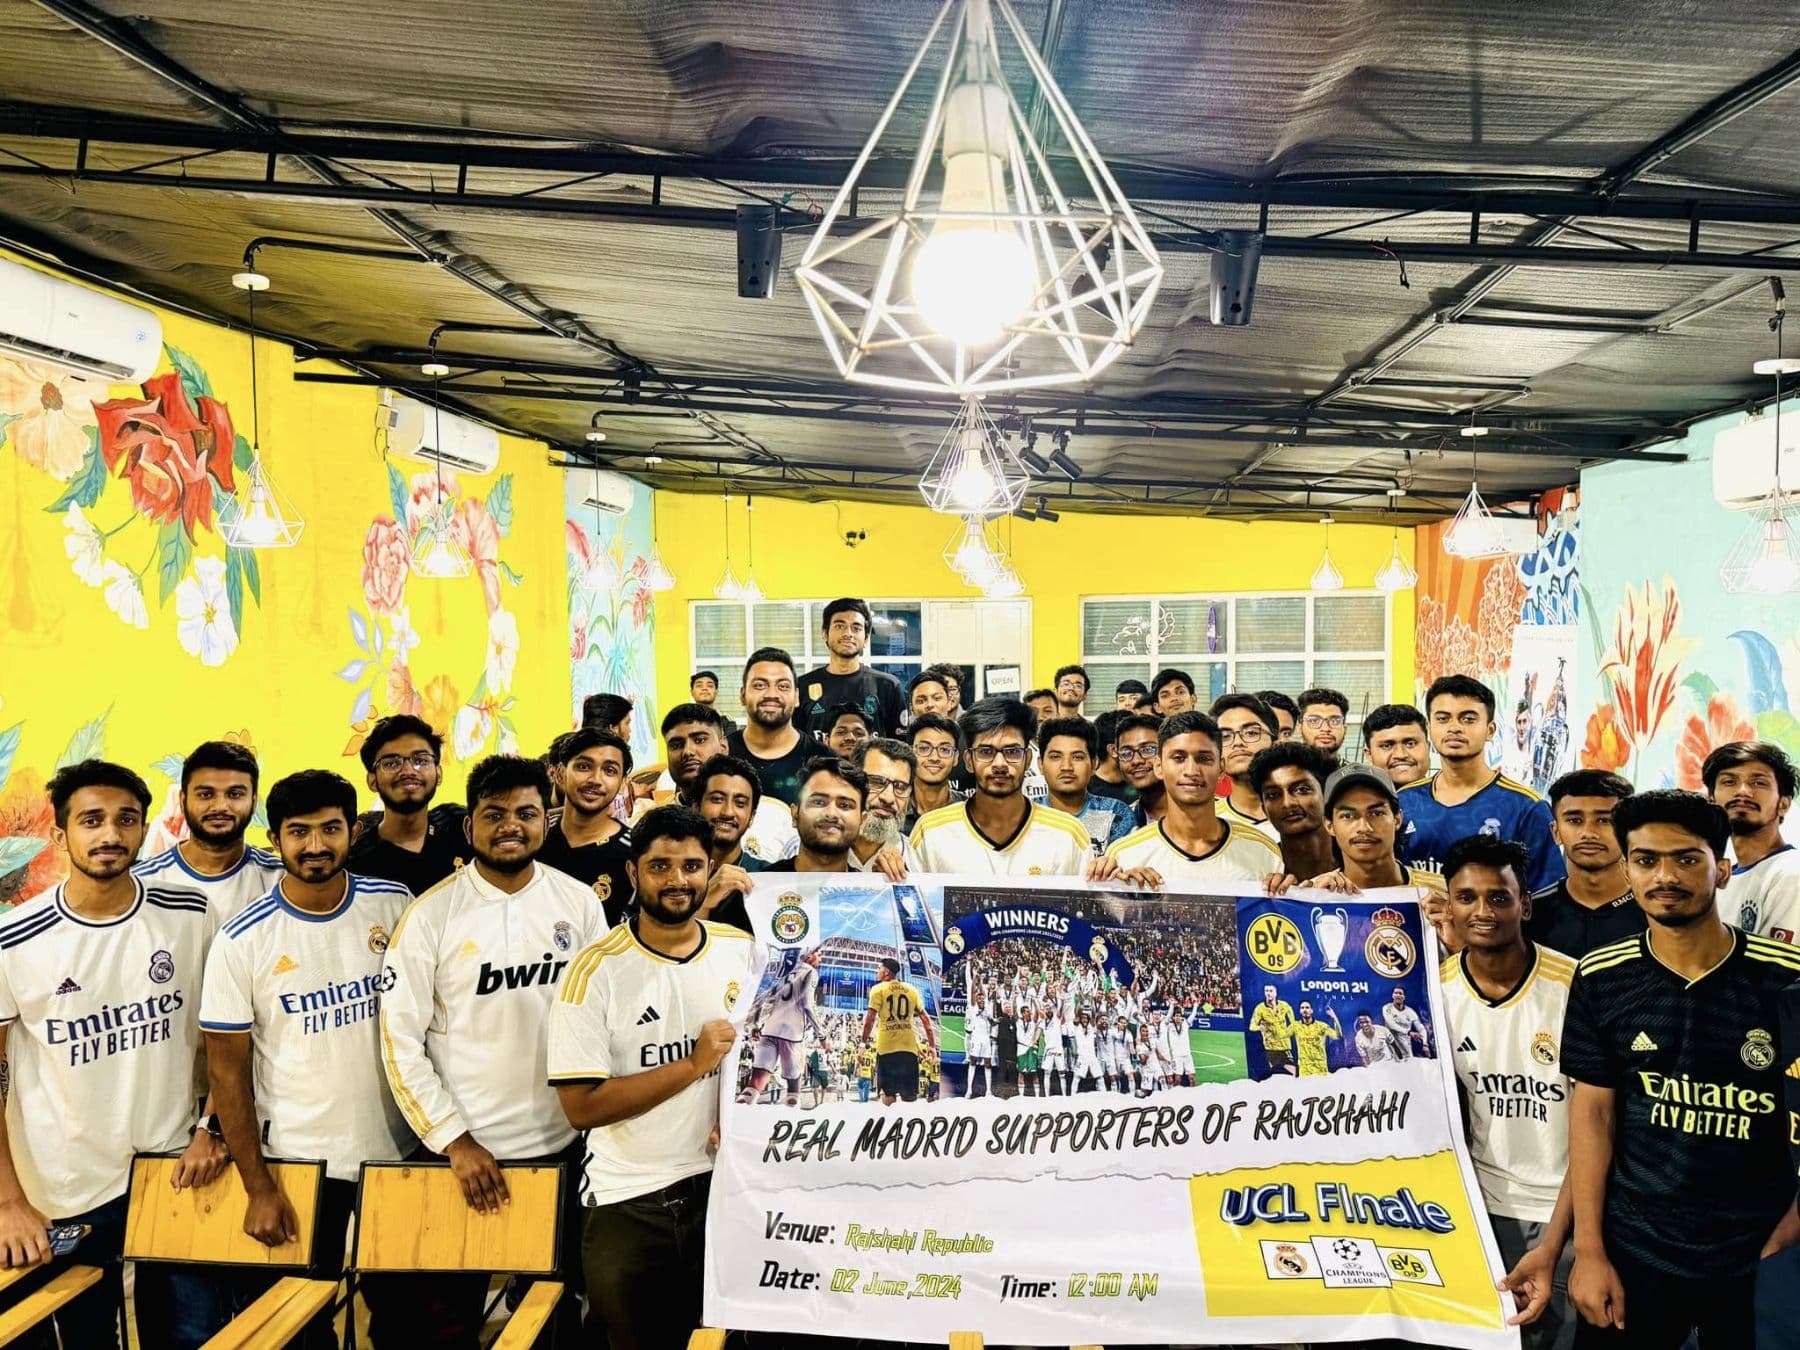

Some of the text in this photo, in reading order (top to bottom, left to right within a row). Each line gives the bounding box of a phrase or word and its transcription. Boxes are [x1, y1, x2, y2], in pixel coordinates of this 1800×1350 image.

[984, 909, 1070, 934] WINNERS
[1253, 919, 1299, 955] BVB
[1267, 954, 1285, 967] 09
[278, 973, 382, 1014] Emirate
[1351, 981, 1370, 994] 24
[46, 989, 184, 1044] Emirates
[886, 993, 909, 1021] 10
[941, 1004, 967, 1014] EAGU
[304, 1012, 328, 1035] FLY
[70, 1018, 171, 1067] FLY BETTER
[762, 1091, 1410, 1163] REAL MADRID SUPPORTERS OF RAJSHAHI
[1650, 1102, 1751, 1140] FLY BETTER
[1219, 1183, 1310, 1225] UCL
[764, 1210, 994, 1256] Venue: Rajshahi Republic
[758, 1261, 820, 1291] Date:
[830, 1269, 860, 1293] 02
[1000, 1272, 1159, 1302] Time: 12:00 AM
[1325, 1269, 1388, 1279] CHAMPIONS
[1342, 1277, 1374, 1285] LEAGUE
